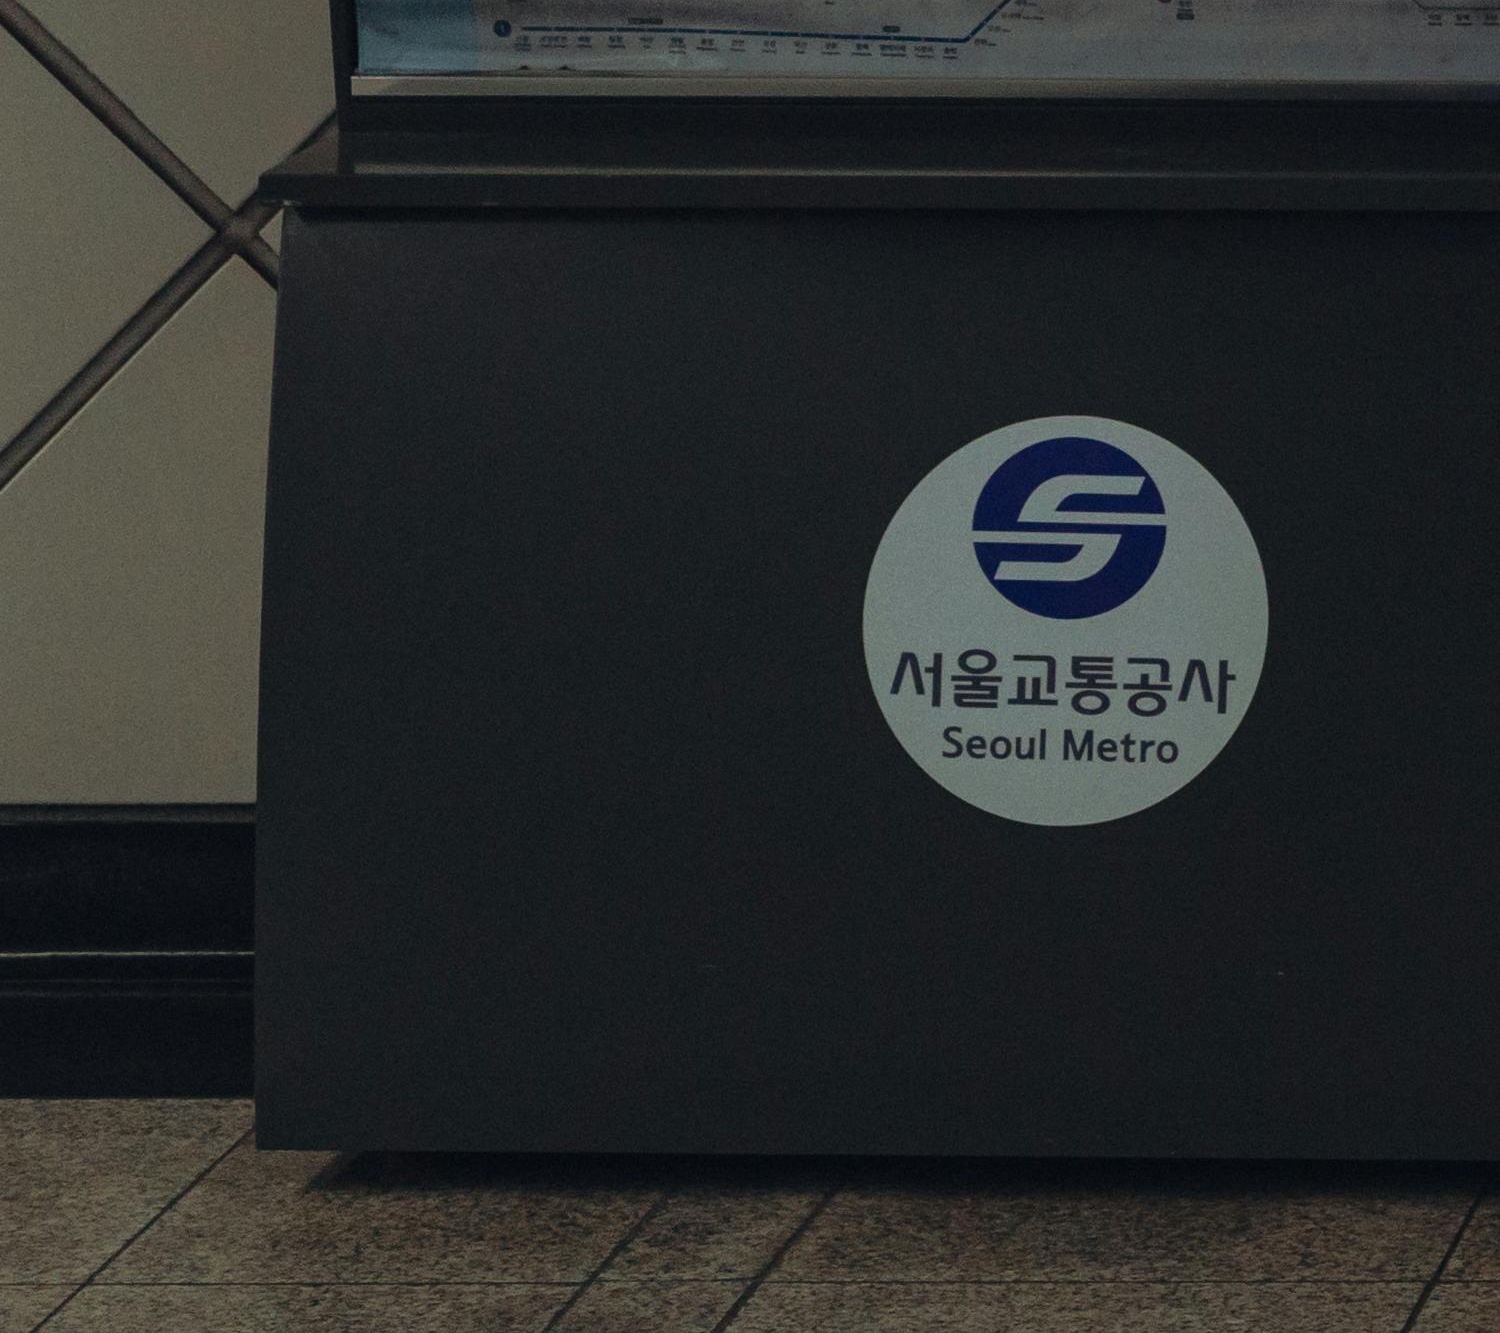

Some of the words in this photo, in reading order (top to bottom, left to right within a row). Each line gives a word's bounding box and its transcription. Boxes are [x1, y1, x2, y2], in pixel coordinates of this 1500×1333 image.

[890, 648, 1237, 718] 서울교통공사
[941, 725, 1047, 761] Seoul
[1062, 728, 1179, 765] Metro
